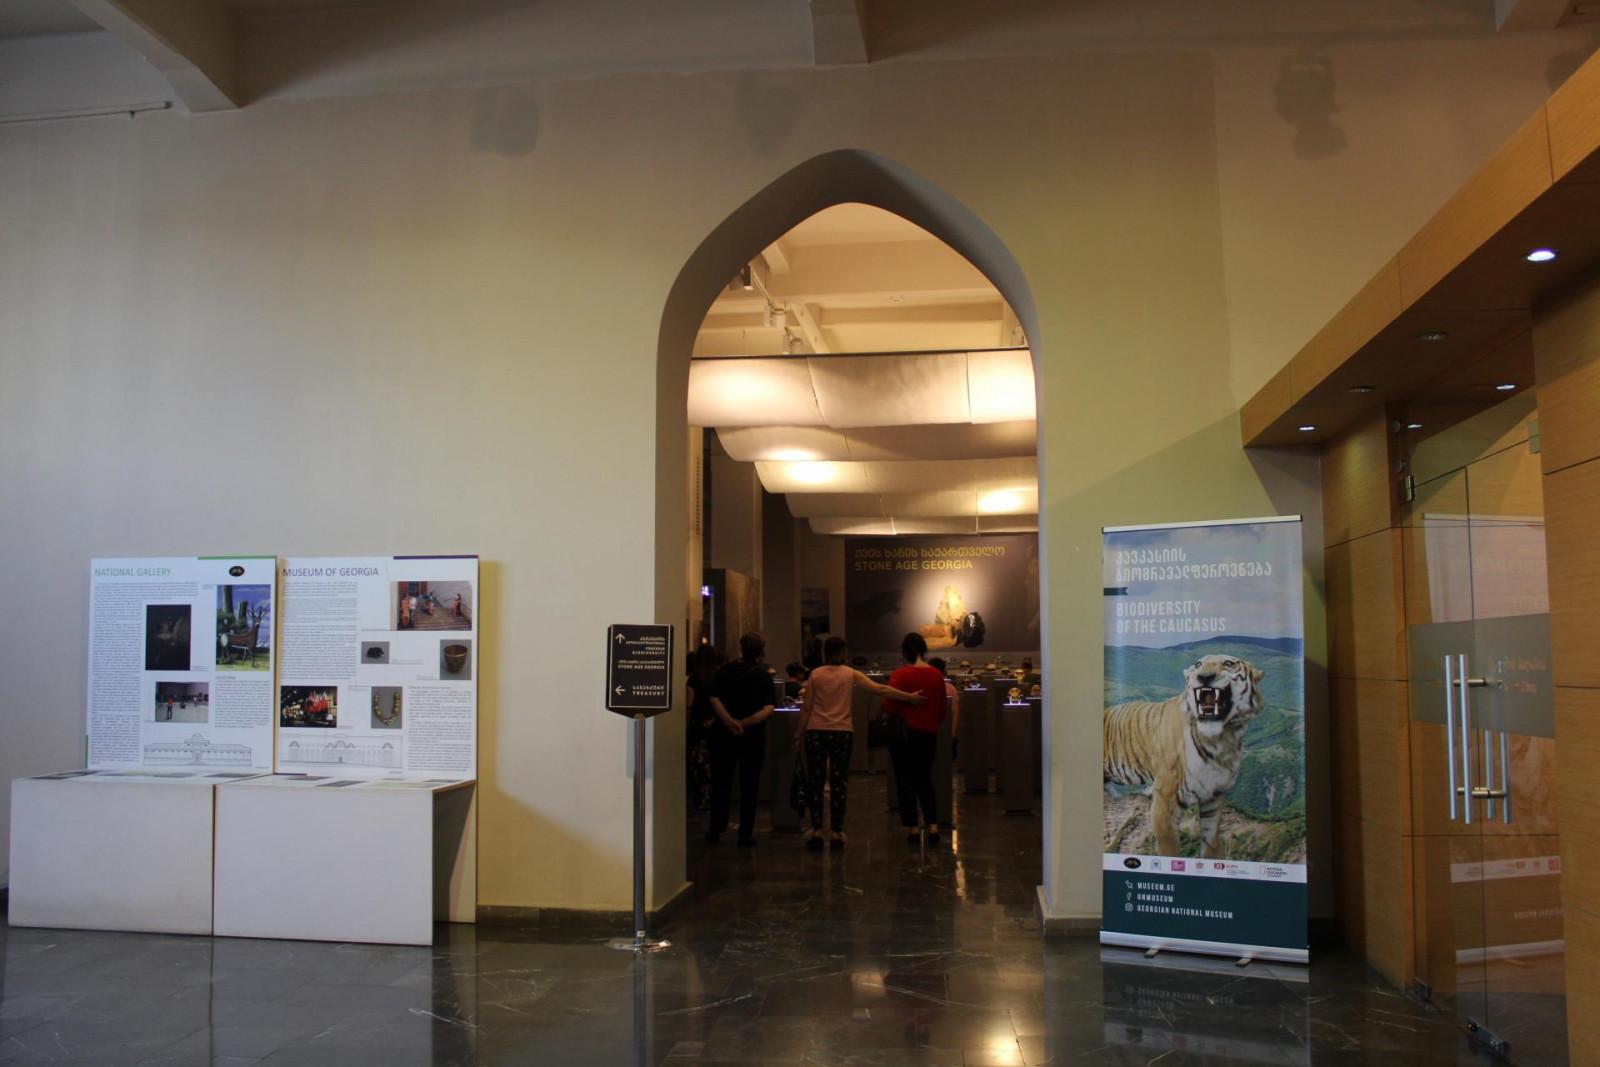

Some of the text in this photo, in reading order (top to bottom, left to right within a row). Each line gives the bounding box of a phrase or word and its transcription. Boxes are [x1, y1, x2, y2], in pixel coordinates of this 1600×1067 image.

[856, 559, 974, 571] STONE AGE GEORGIA
[94, 567, 171, 577] NATIONAL GALLERY
[283, 567, 379, 577] MUSEUM OF GEORGIA
[1116, 600, 1201, 617] BIODIVERSITY
[1116, 617, 1227, 634] OF THE CAUCASUS
[1137, 882, 1175, 891] MUSEUM.GE
[1136, 905, 1234, 919] GEORGIAN NATIONAL MUSEUM
